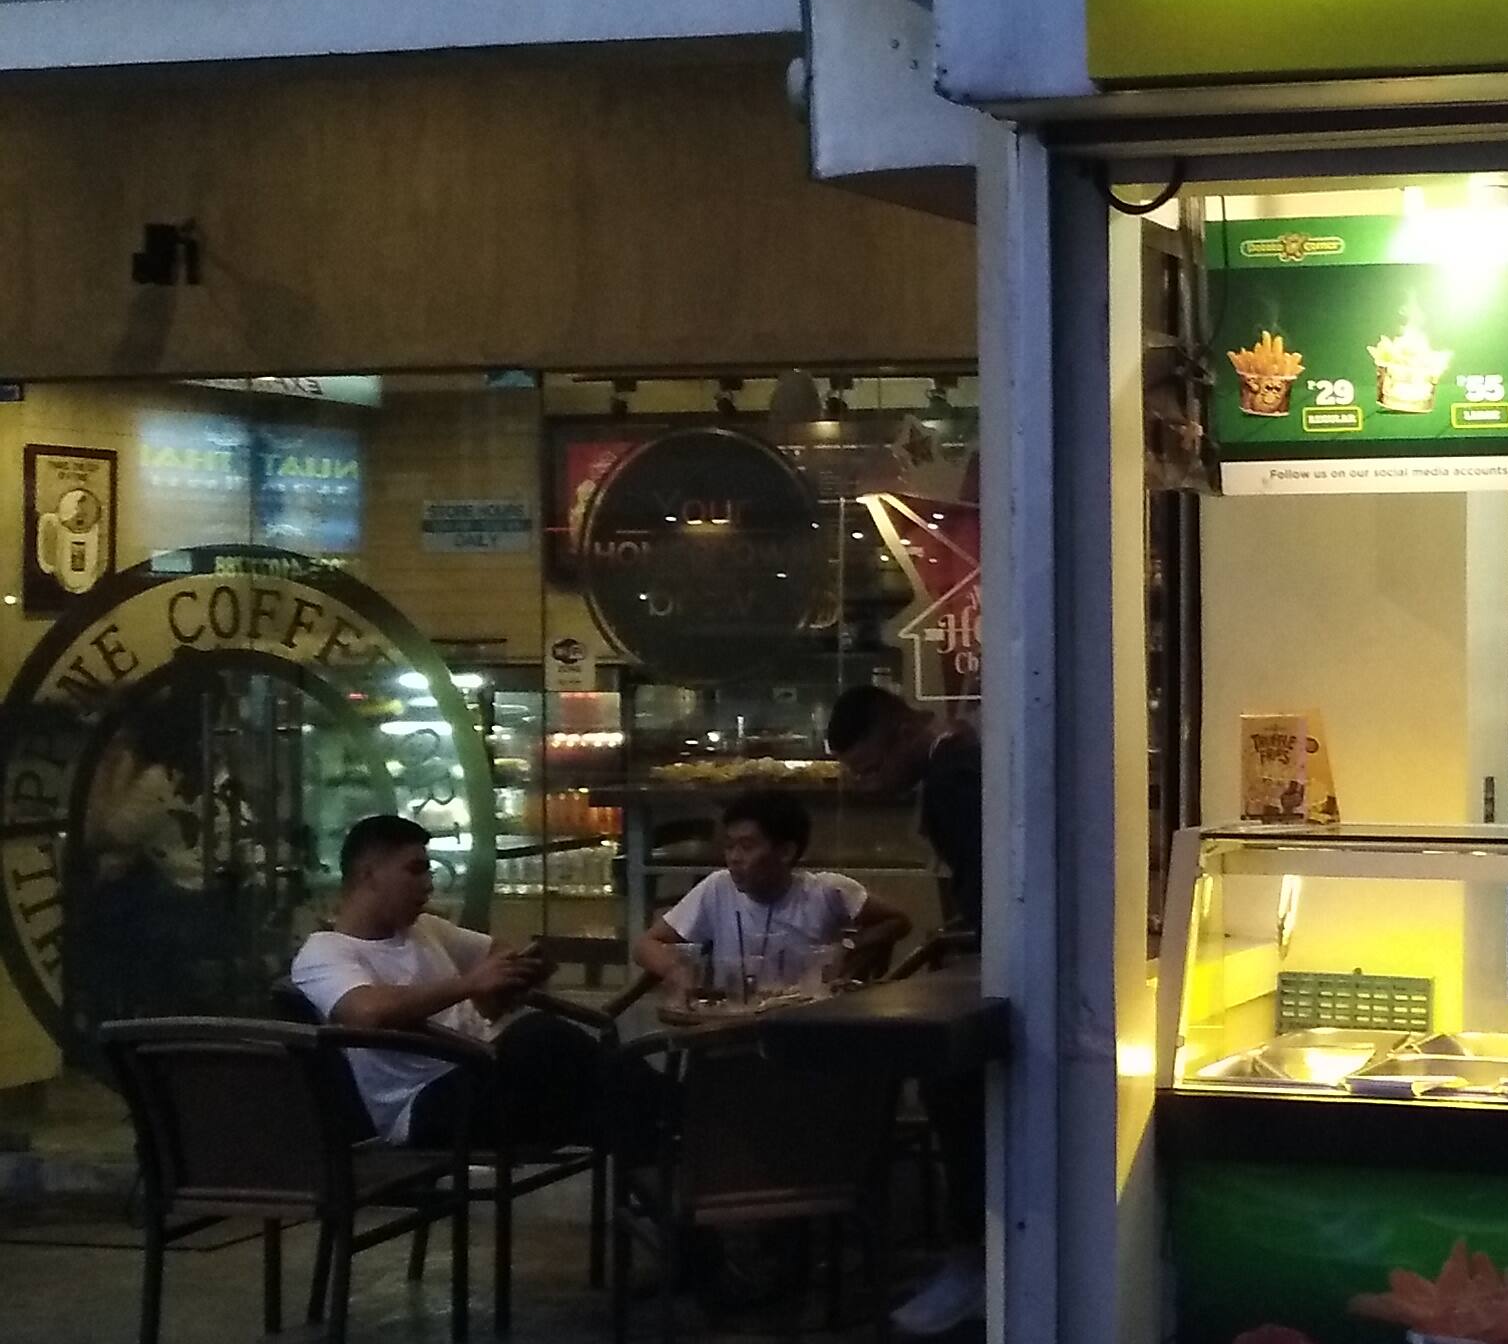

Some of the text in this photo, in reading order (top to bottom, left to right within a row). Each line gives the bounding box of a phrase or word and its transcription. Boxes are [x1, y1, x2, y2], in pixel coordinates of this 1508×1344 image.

[1270, 466, 1508, 479] Follow us on our social media accounts
